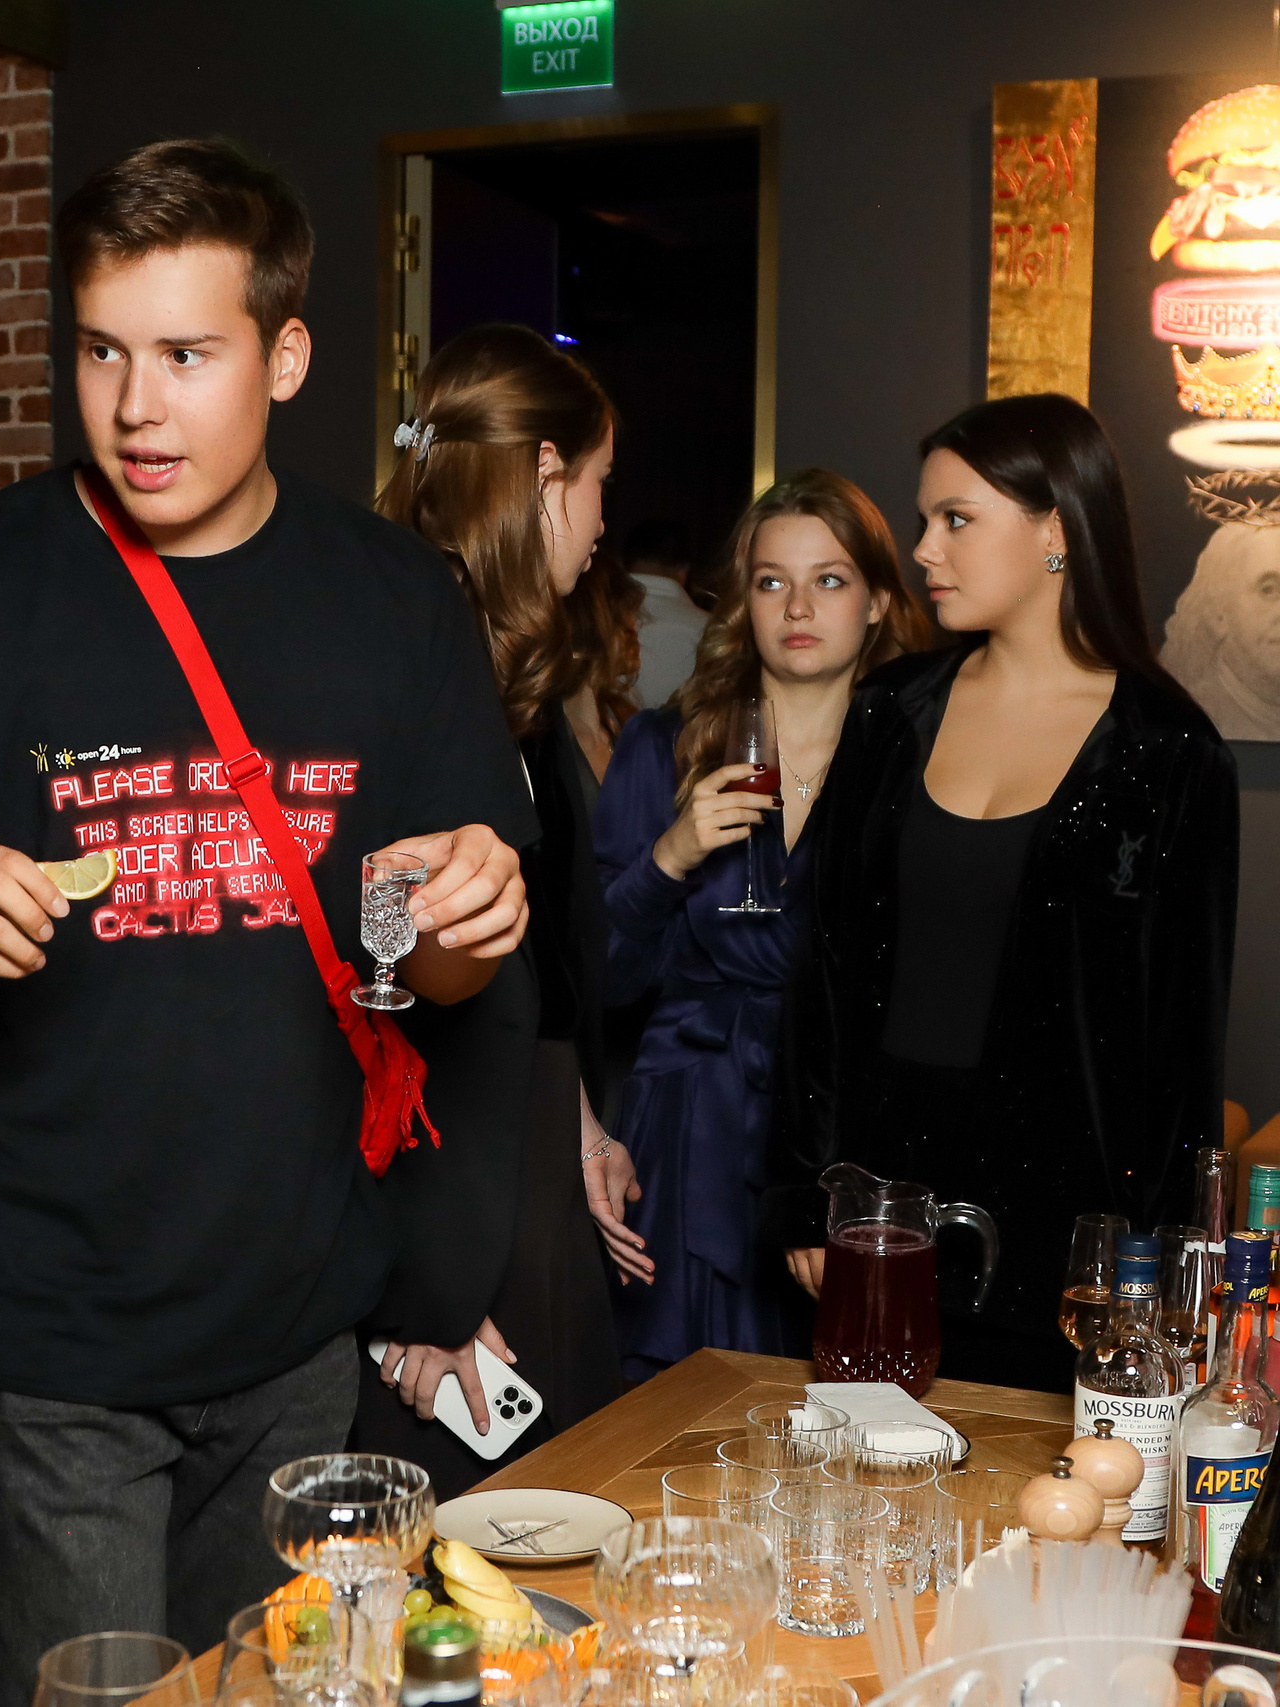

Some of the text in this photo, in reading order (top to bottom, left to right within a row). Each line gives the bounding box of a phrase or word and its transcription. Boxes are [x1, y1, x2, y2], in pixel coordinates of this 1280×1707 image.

[514, 15, 599, 46] ВЫХОД
[532, 47, 581, 75] EXIT
[77, 744, 143, 762] open 24 hours
[52, 764, 174, 810] PLEASE
[288, 763, 358, 792] HERE
[75, 820, 118, 847] THIS
[128, 813, 194, 838] SCREEN
[198, 810, 250, 833] HELPS
[114, 882, 146, 905] AND
[158, 878, 214, 901] PROMPT
[94, 897, 301, 938] CACTUS JAC
[1083, 1399, 1175, 1422] MOSSBURN
[1138, 1445, 1169, 1455] HISKY
